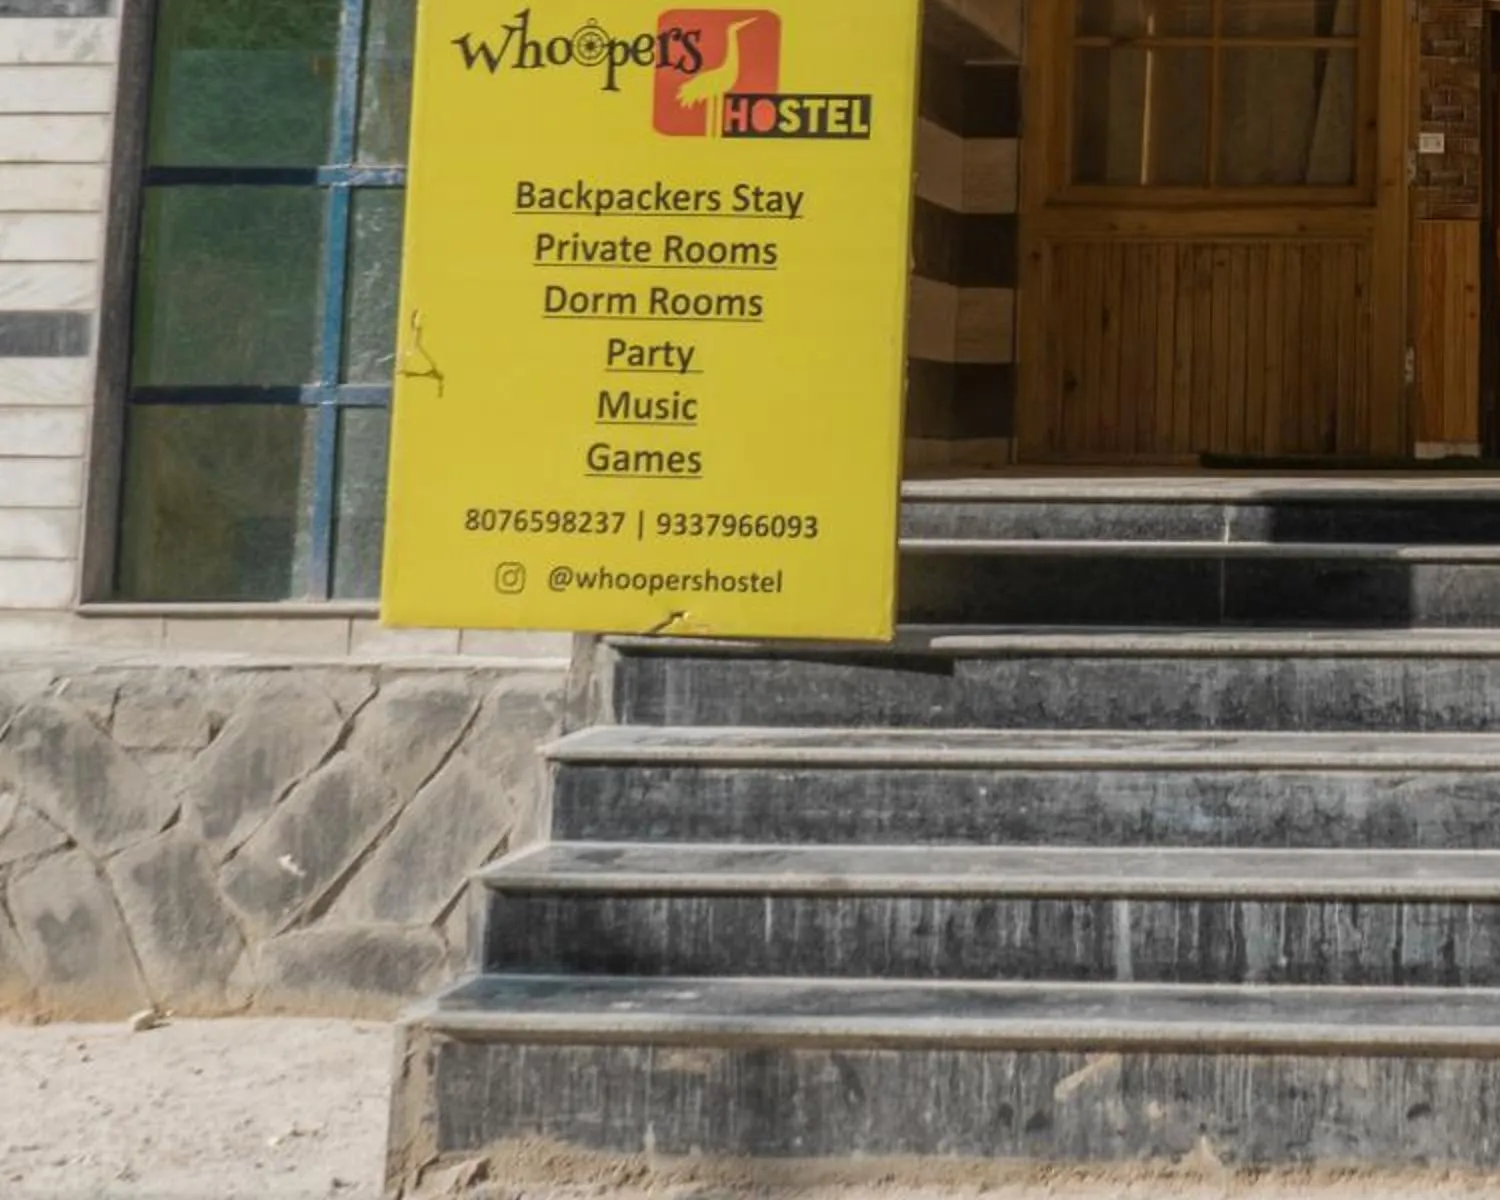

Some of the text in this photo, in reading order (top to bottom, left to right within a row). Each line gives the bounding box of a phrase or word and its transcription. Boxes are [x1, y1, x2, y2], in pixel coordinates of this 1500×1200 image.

[723, 98, 870, 134] HOSTEL
[514, 179, 804, 220] Backpackers Stay
[534, 233, 778, 266] Private Rooms
[544, 285, 763, 318] Dorm Rooms
[607, 337, 694, 373] Party
[597, 390, 697, 421] Music
[586, 442, 702, 474] Games
[465, 508, 625, 534] 8076598237
[656, 512, 818, 538] 9337966093
[548, 565, 782, 596] @whoopershostel
